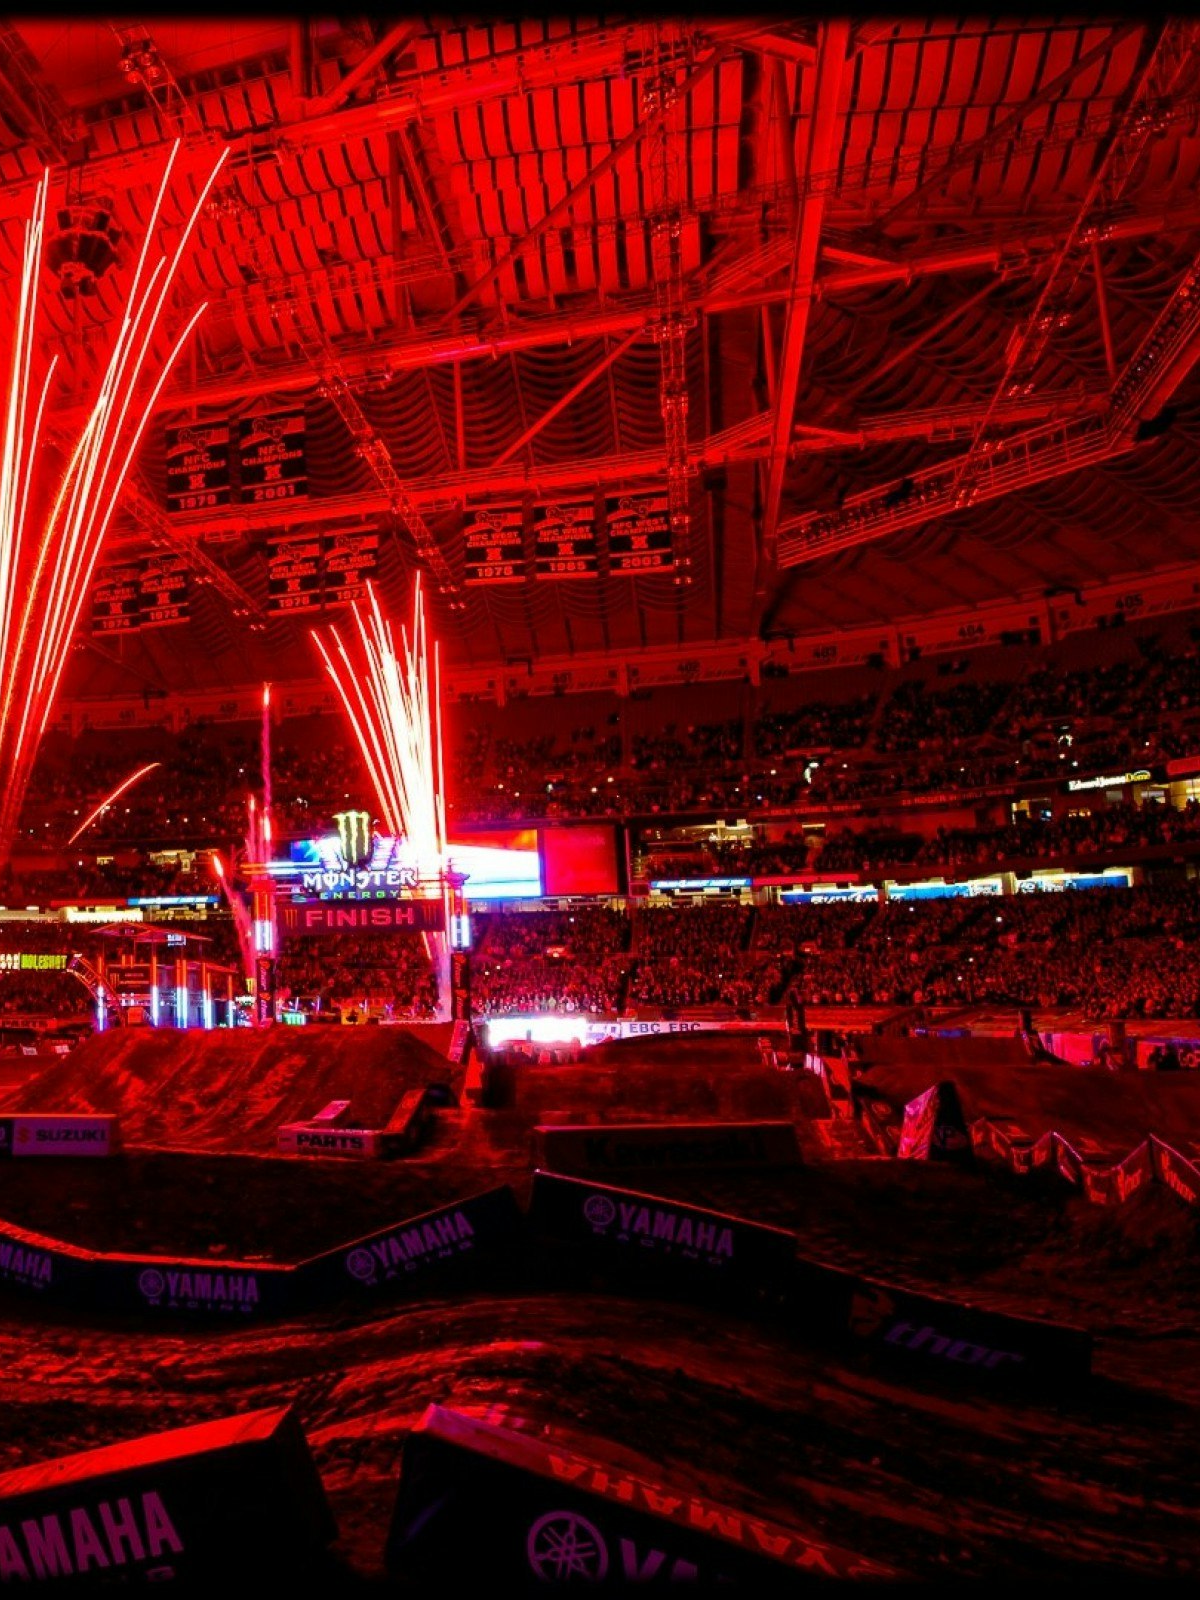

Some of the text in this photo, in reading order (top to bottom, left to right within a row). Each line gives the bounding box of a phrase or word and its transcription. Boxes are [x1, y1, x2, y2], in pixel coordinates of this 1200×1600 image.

[258, 443, 285, 456] NFC
[184, 453, 210, 465] NFC
[242, 450, 303, 466] CHAMPIONS
[168, 459, 226, 475] CHAMPIONS
[254, 484, 295, 500] 2001
[622, 555, 661, 568] 2003
[303, 868, 417, 891] MONSTER
[305, 908, 415, 928] FINISH
[629, 1023, 700, 1034] EBC EBC
[36, 1128, 107, 1142] SUZUKI
[296, 1134, 364, 1149] PARTS
[617, 1201, 735, 1258] YAMAHA
[371, 1209, 477, 1268] YAMAHA
[165, 1273, 261, 1304] YAMAHA
